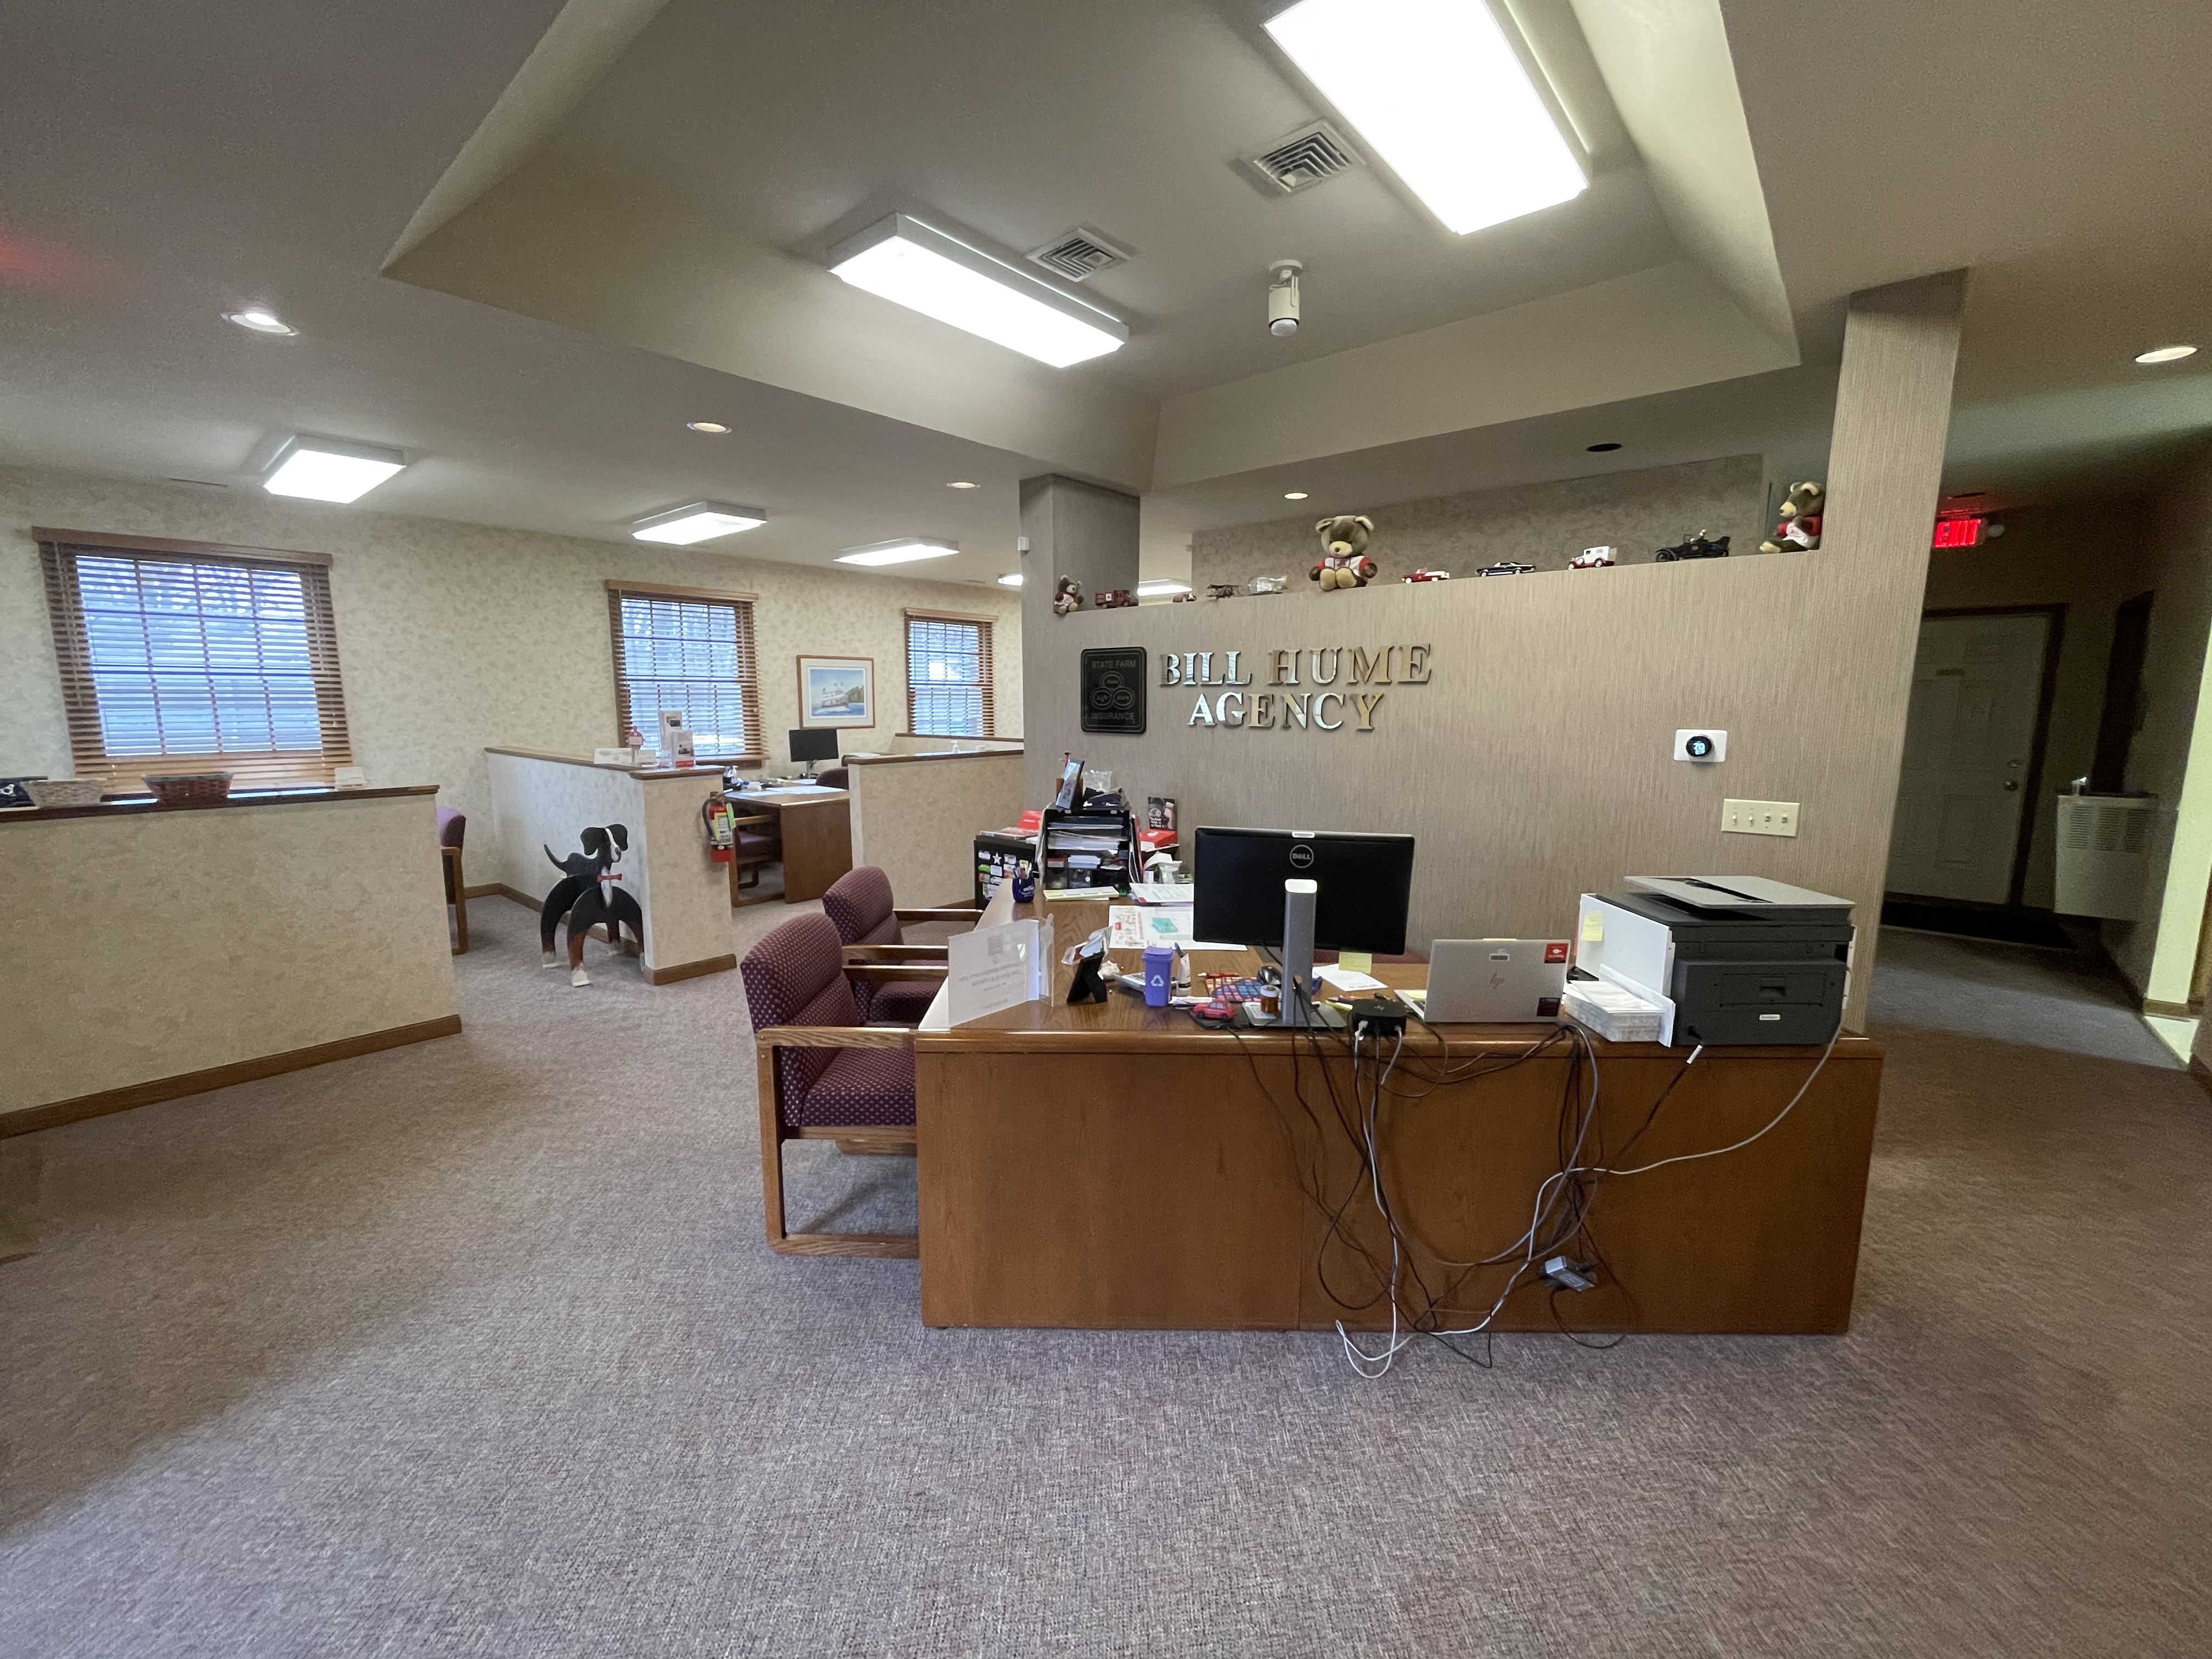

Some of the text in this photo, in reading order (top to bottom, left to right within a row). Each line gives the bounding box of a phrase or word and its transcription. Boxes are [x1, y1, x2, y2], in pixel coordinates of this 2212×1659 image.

[1934, 518, 1981, 548] EXIT
[1091, 659, 1136, 669] STATE FARM
[1159, 643, 1432, 686] BILL HUME
[1090, 712, 1135, 720] INSURANCE
[1188, 691, 1385, 731] AGENCY
